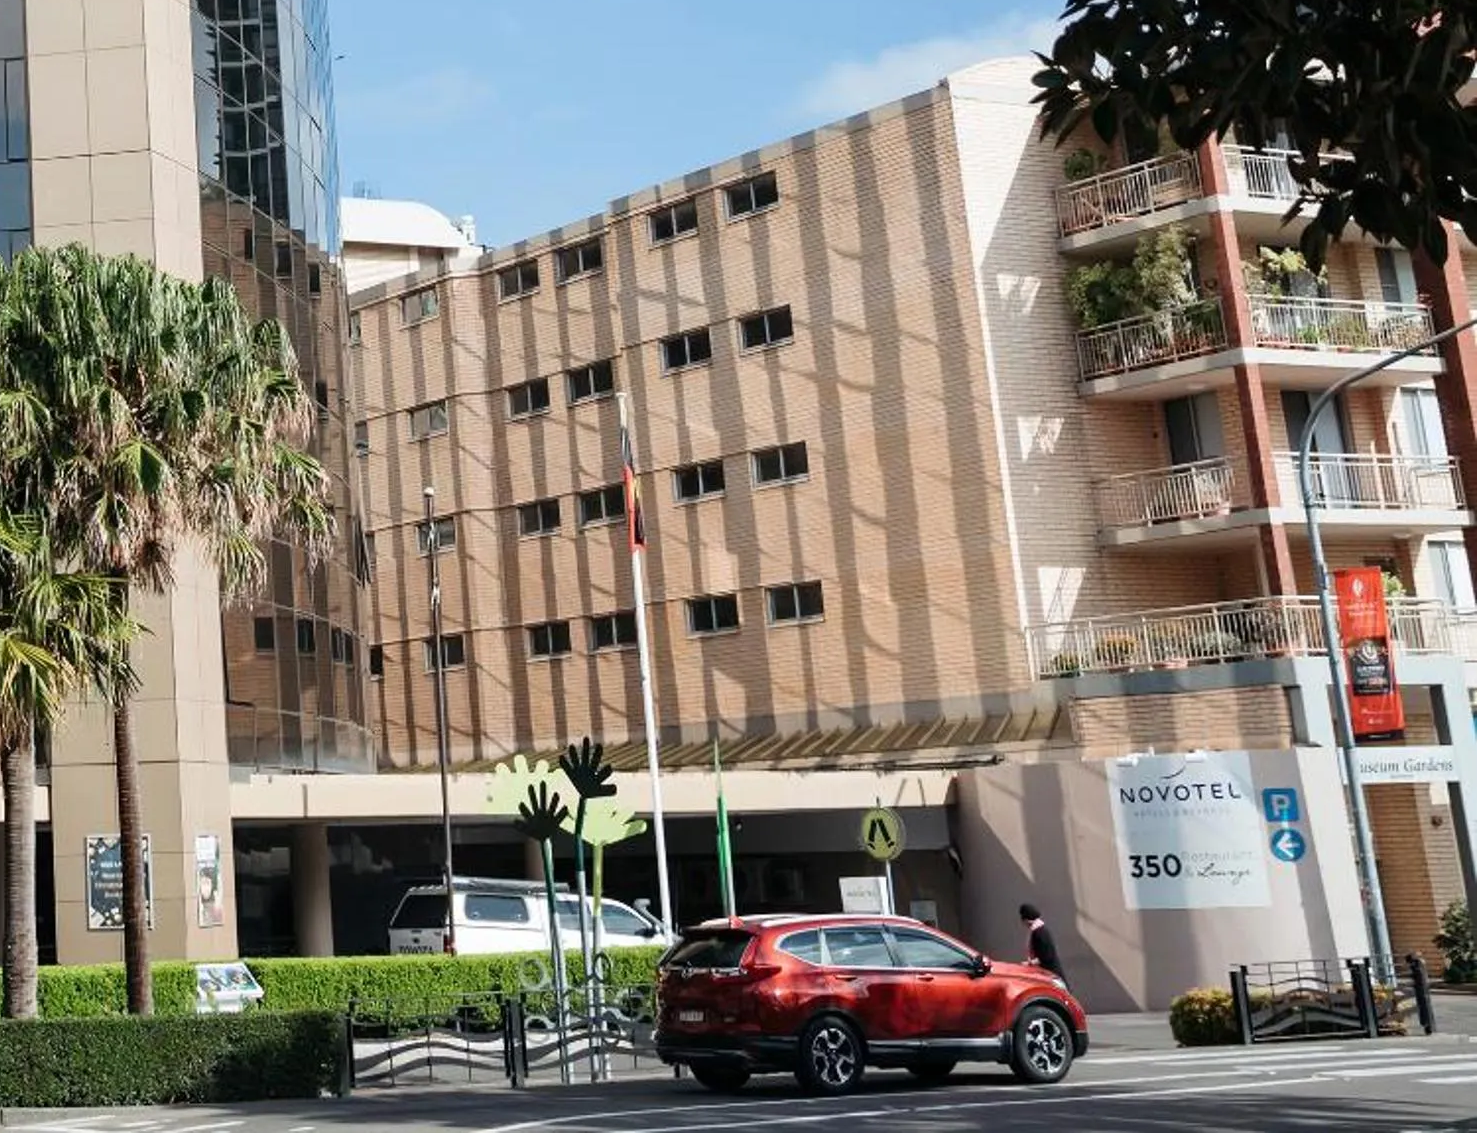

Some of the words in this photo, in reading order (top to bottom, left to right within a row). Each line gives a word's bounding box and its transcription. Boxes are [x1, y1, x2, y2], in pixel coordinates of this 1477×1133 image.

[1360, 762, 1399, 773] useum
[1120, 782, 1242, 804] NOVOTEL
[1129, 854, 1183, 879] 350
